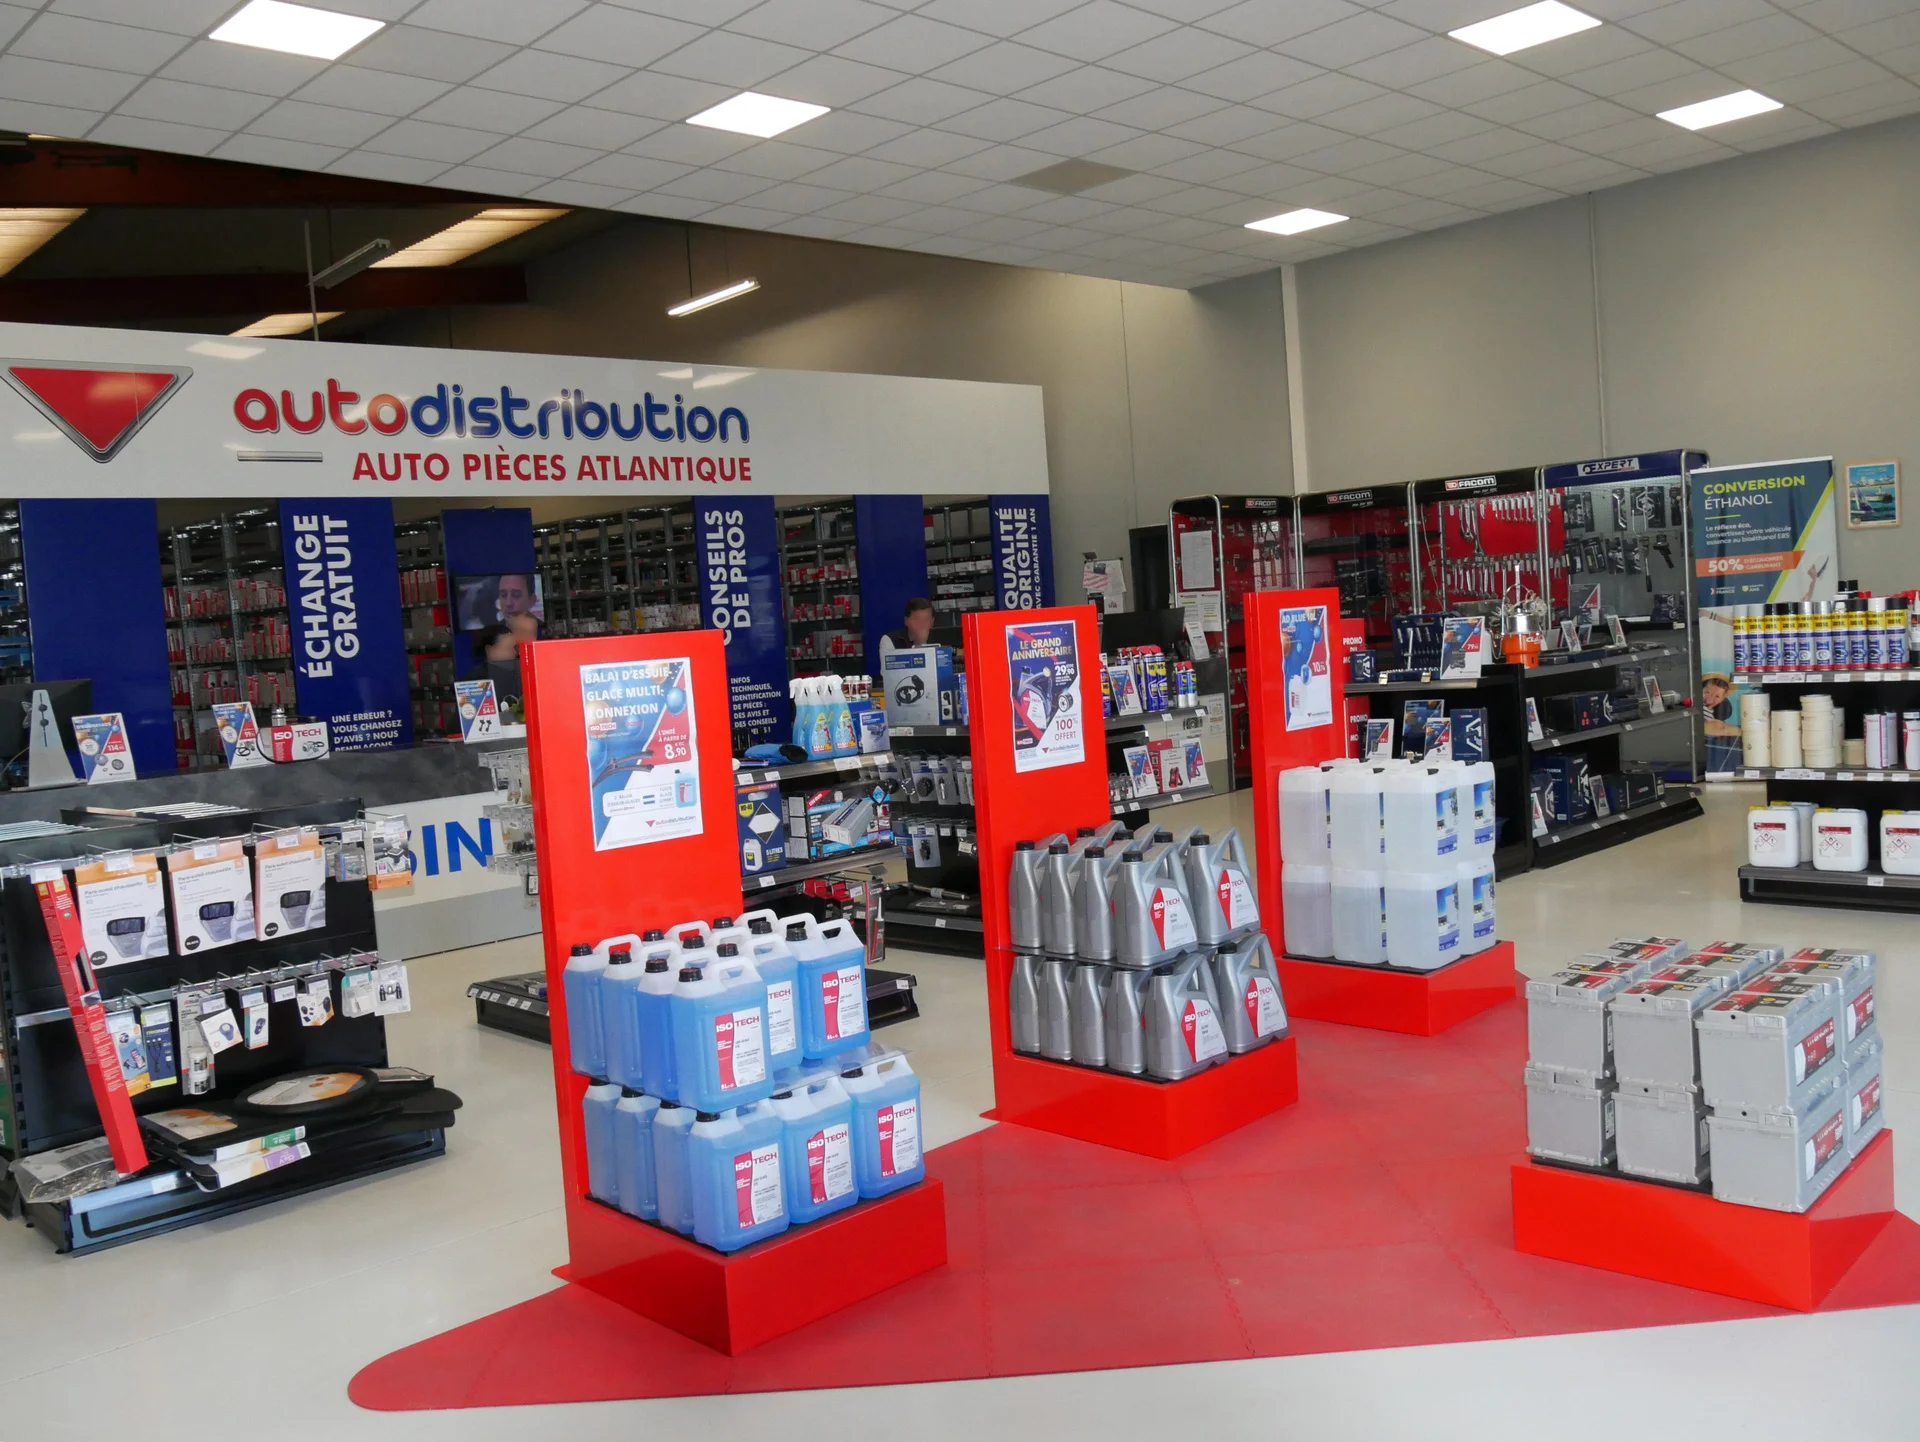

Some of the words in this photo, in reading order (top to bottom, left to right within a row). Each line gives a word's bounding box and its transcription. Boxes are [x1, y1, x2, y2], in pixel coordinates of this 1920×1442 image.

[234, 378, 750, 443] autodistribution
[353, 452, 449, 481] AUTO
[463, 445, 566, 481] PIÈCES
[577, 455, 752, 483] ATLANTIQUE
[1459, 478, 1494, 487] FACOM
[1704, 475, 1806, 495] CONVERSION
[1339, 492, 1370, 500] FACOM
[1705, 494, 1772, 510] ÉTHANOL
[1030, 508, 1036, 523] AN
[1706, 530, 1745, 538] convertissez
[726, 510, 748, 583] PROS
[994, 508, 1019, 610] QUALITÉ
[1032, 534, 1040, 583] GARANTIE
[1708, 558, 1744, 572] 50%
[322, 516, 360, 658] GRATUIT
[293, 516, 333, 678] ÉCHANGE
[732, 592, 751, 628] DE
[1282, 615, 1290, 624] AD
[1292, 614, 1306, 622] BLUE
[1020, 640, 1029, 650] LE
[1030, 637, 1062, 648] GRAND
[1342, 637, 1362, 646] PROMO
[1012, 646, 1072, 660] ANNIVERSAIRE
[585, 671, 618, 684] BALAI
[622, 667, 672, 680] D'ESSUIE-
[730, 676, 750, 684] INFOS
[732, 683, 772, 692] TECHNIQUES,
[587, 689, 623, 702] GLACE
[732, 690, 781, 702] IDENTIFICATION
[733, 702, 743, 710] DE
[744, 700, 762, 710] PIÈCES
[332, 714, 351, 723] UNE
[353, 711, 385, 722] ERREUR
[734, 712, 746, 720] DES
[747, 710, 761, 718] AVIS
[1350, 714, 1368, 722] PROMO
[333, 724, 352, 734] VOUS
[354, 720, 402, 731] CHANGEZ
[734, 720, 747, 728] DES
[748, 717, 777, 726] CONSEILS
[274, 732, 292, 740] ISO
[296, 728, 321, 737] TECH
[334, 734, 364, 744] D'AVIS
[373, 730, 398, 740] NOUS
[1054, 731, 1076, 740] OFFERT
[408, 817, 493, 876] IN
[823, 979, 838, 988] ISO
[840, 974, 860, 984] TECH
[768, 989, 791, 999] TECH
[716, 1022, 733, 1032] ISO
[735, 1016, 760, 1027] TECH
[878, 1114, 893, 1124] ISO
[894, 1107, 915, 1118] TECH
[808, 1139, 824, 1150] ISO
[826, 1131, 847, 1143] TECH
[736, 1160, 751, 1171] ISO
[754, 1152, 777, 1164] TECH
